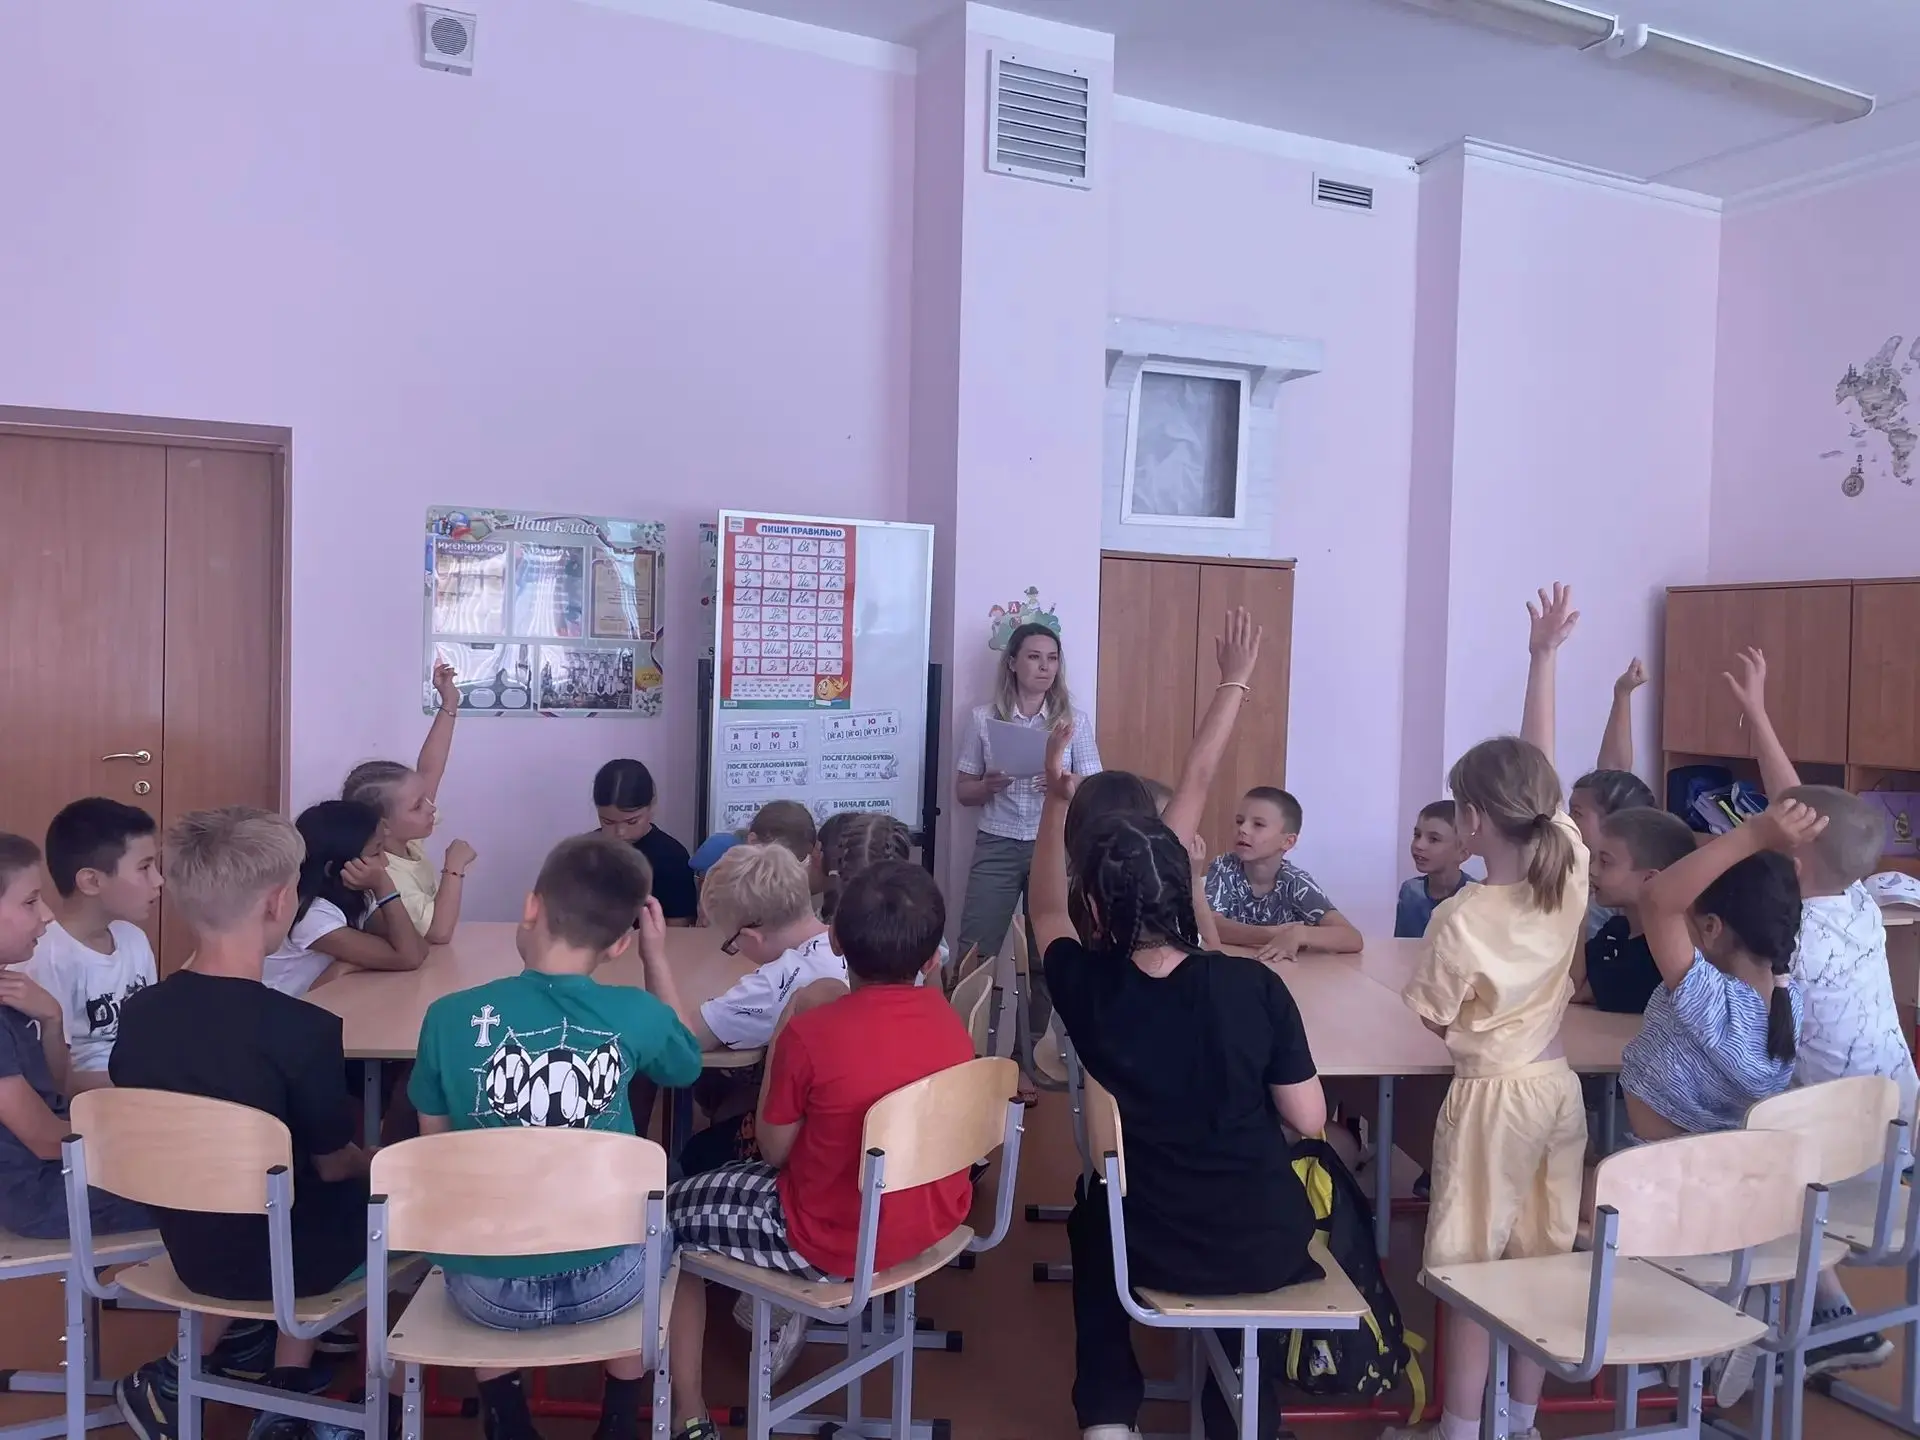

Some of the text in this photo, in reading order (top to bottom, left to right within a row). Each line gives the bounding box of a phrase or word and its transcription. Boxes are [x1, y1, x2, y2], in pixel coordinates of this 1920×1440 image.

[512, 515, 551, 532] Наш
[761, 525, 842, 536] ПИШИ ПРАВИЛЬНО
[728, 804, 752, 812] ПОСЛЕ
